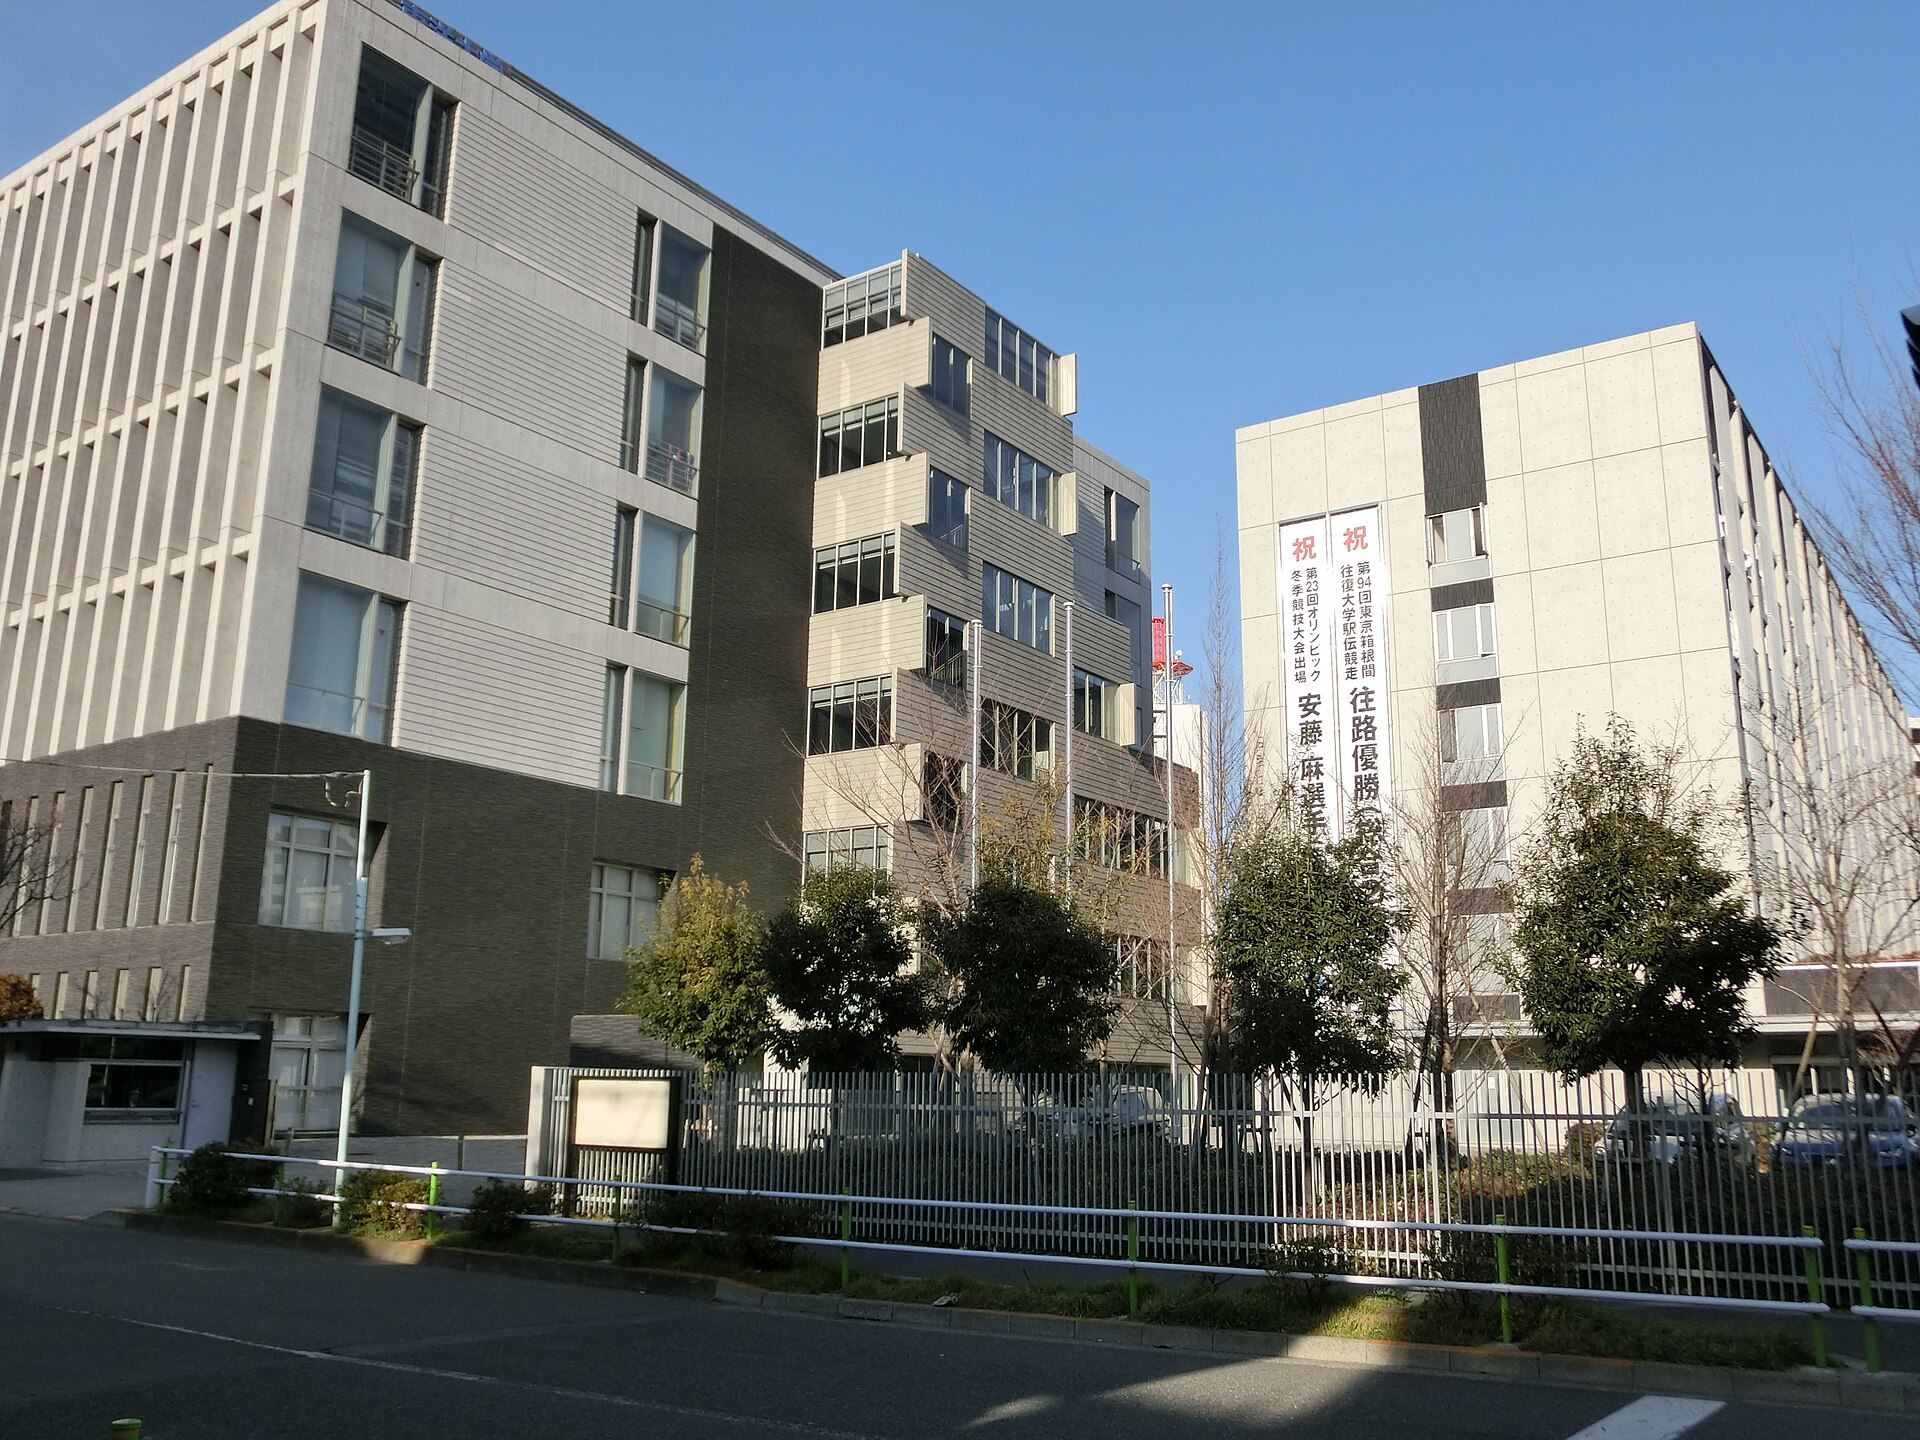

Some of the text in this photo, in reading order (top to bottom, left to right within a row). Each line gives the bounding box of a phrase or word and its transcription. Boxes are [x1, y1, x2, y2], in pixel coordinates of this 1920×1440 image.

[1292, 536, 1317, 561] 祝
[1343, 526, 1369, 552] 祝
[1291, 570, 1307, 684] 冬季競技大会出場
[1305, 567, 1321, 682] 第23回オリンピック
[1340, 564, 1358, 681] 往復大学駅伝競走
[1357, 561, 1376, 679] 第94回東京箱根間
